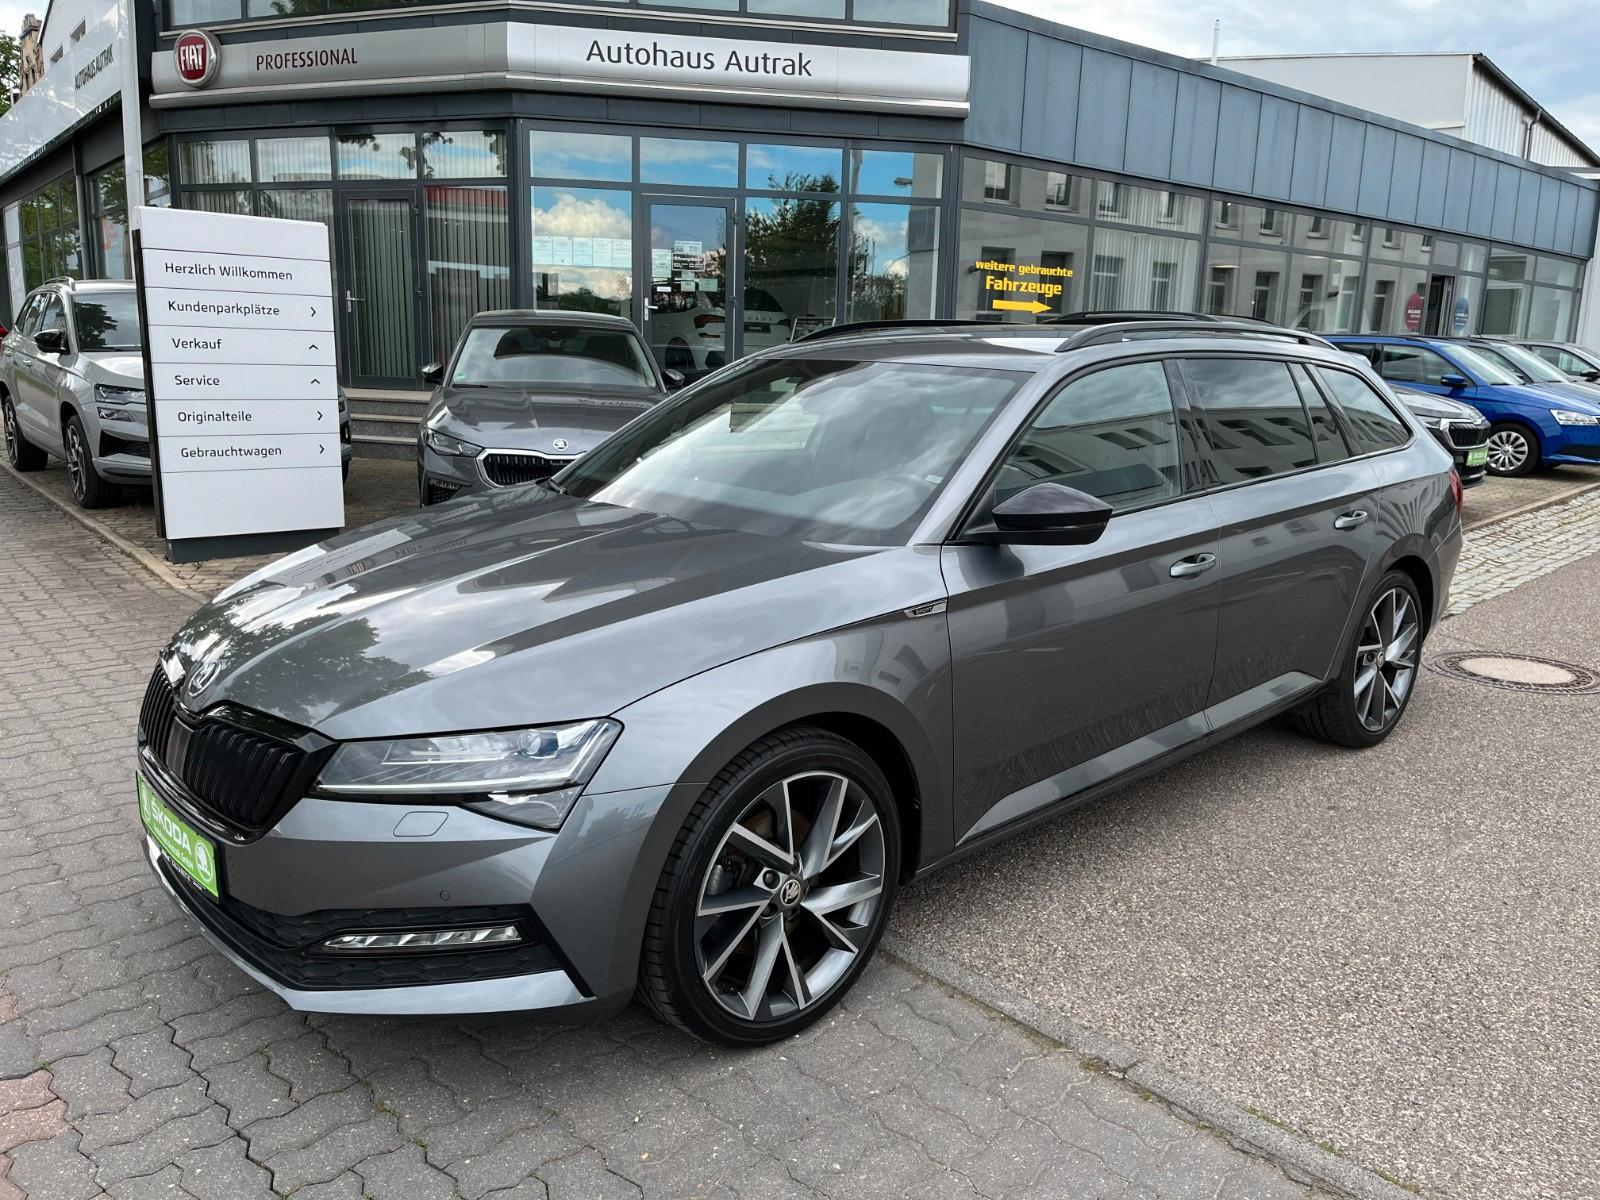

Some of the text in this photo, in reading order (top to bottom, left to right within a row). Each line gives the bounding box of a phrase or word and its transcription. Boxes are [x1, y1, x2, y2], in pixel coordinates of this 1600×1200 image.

[180, 44, 204, 71] FIAT
[256, 48, 358, 71] PROFESSIONAL
[586, 40, 812, 77] Autohaus Autrak
[165, 262, 293, 280] Herzlich Willkommen
[975, 261, 1073, 277] weitere gebrauchte
[985, 275, 1062, 298] Fahrzeuge
[168, 301, 280, 317] Kundenparkplätze
[172, 338, 222, 350] Verkauf
[174, 375, 220, 386] Service
[177, 411, 252, 425] Originalteile
[180, 446, 282, 459] Gebrauchtwagen
[152, 798, 192, 856] ŠKODA
